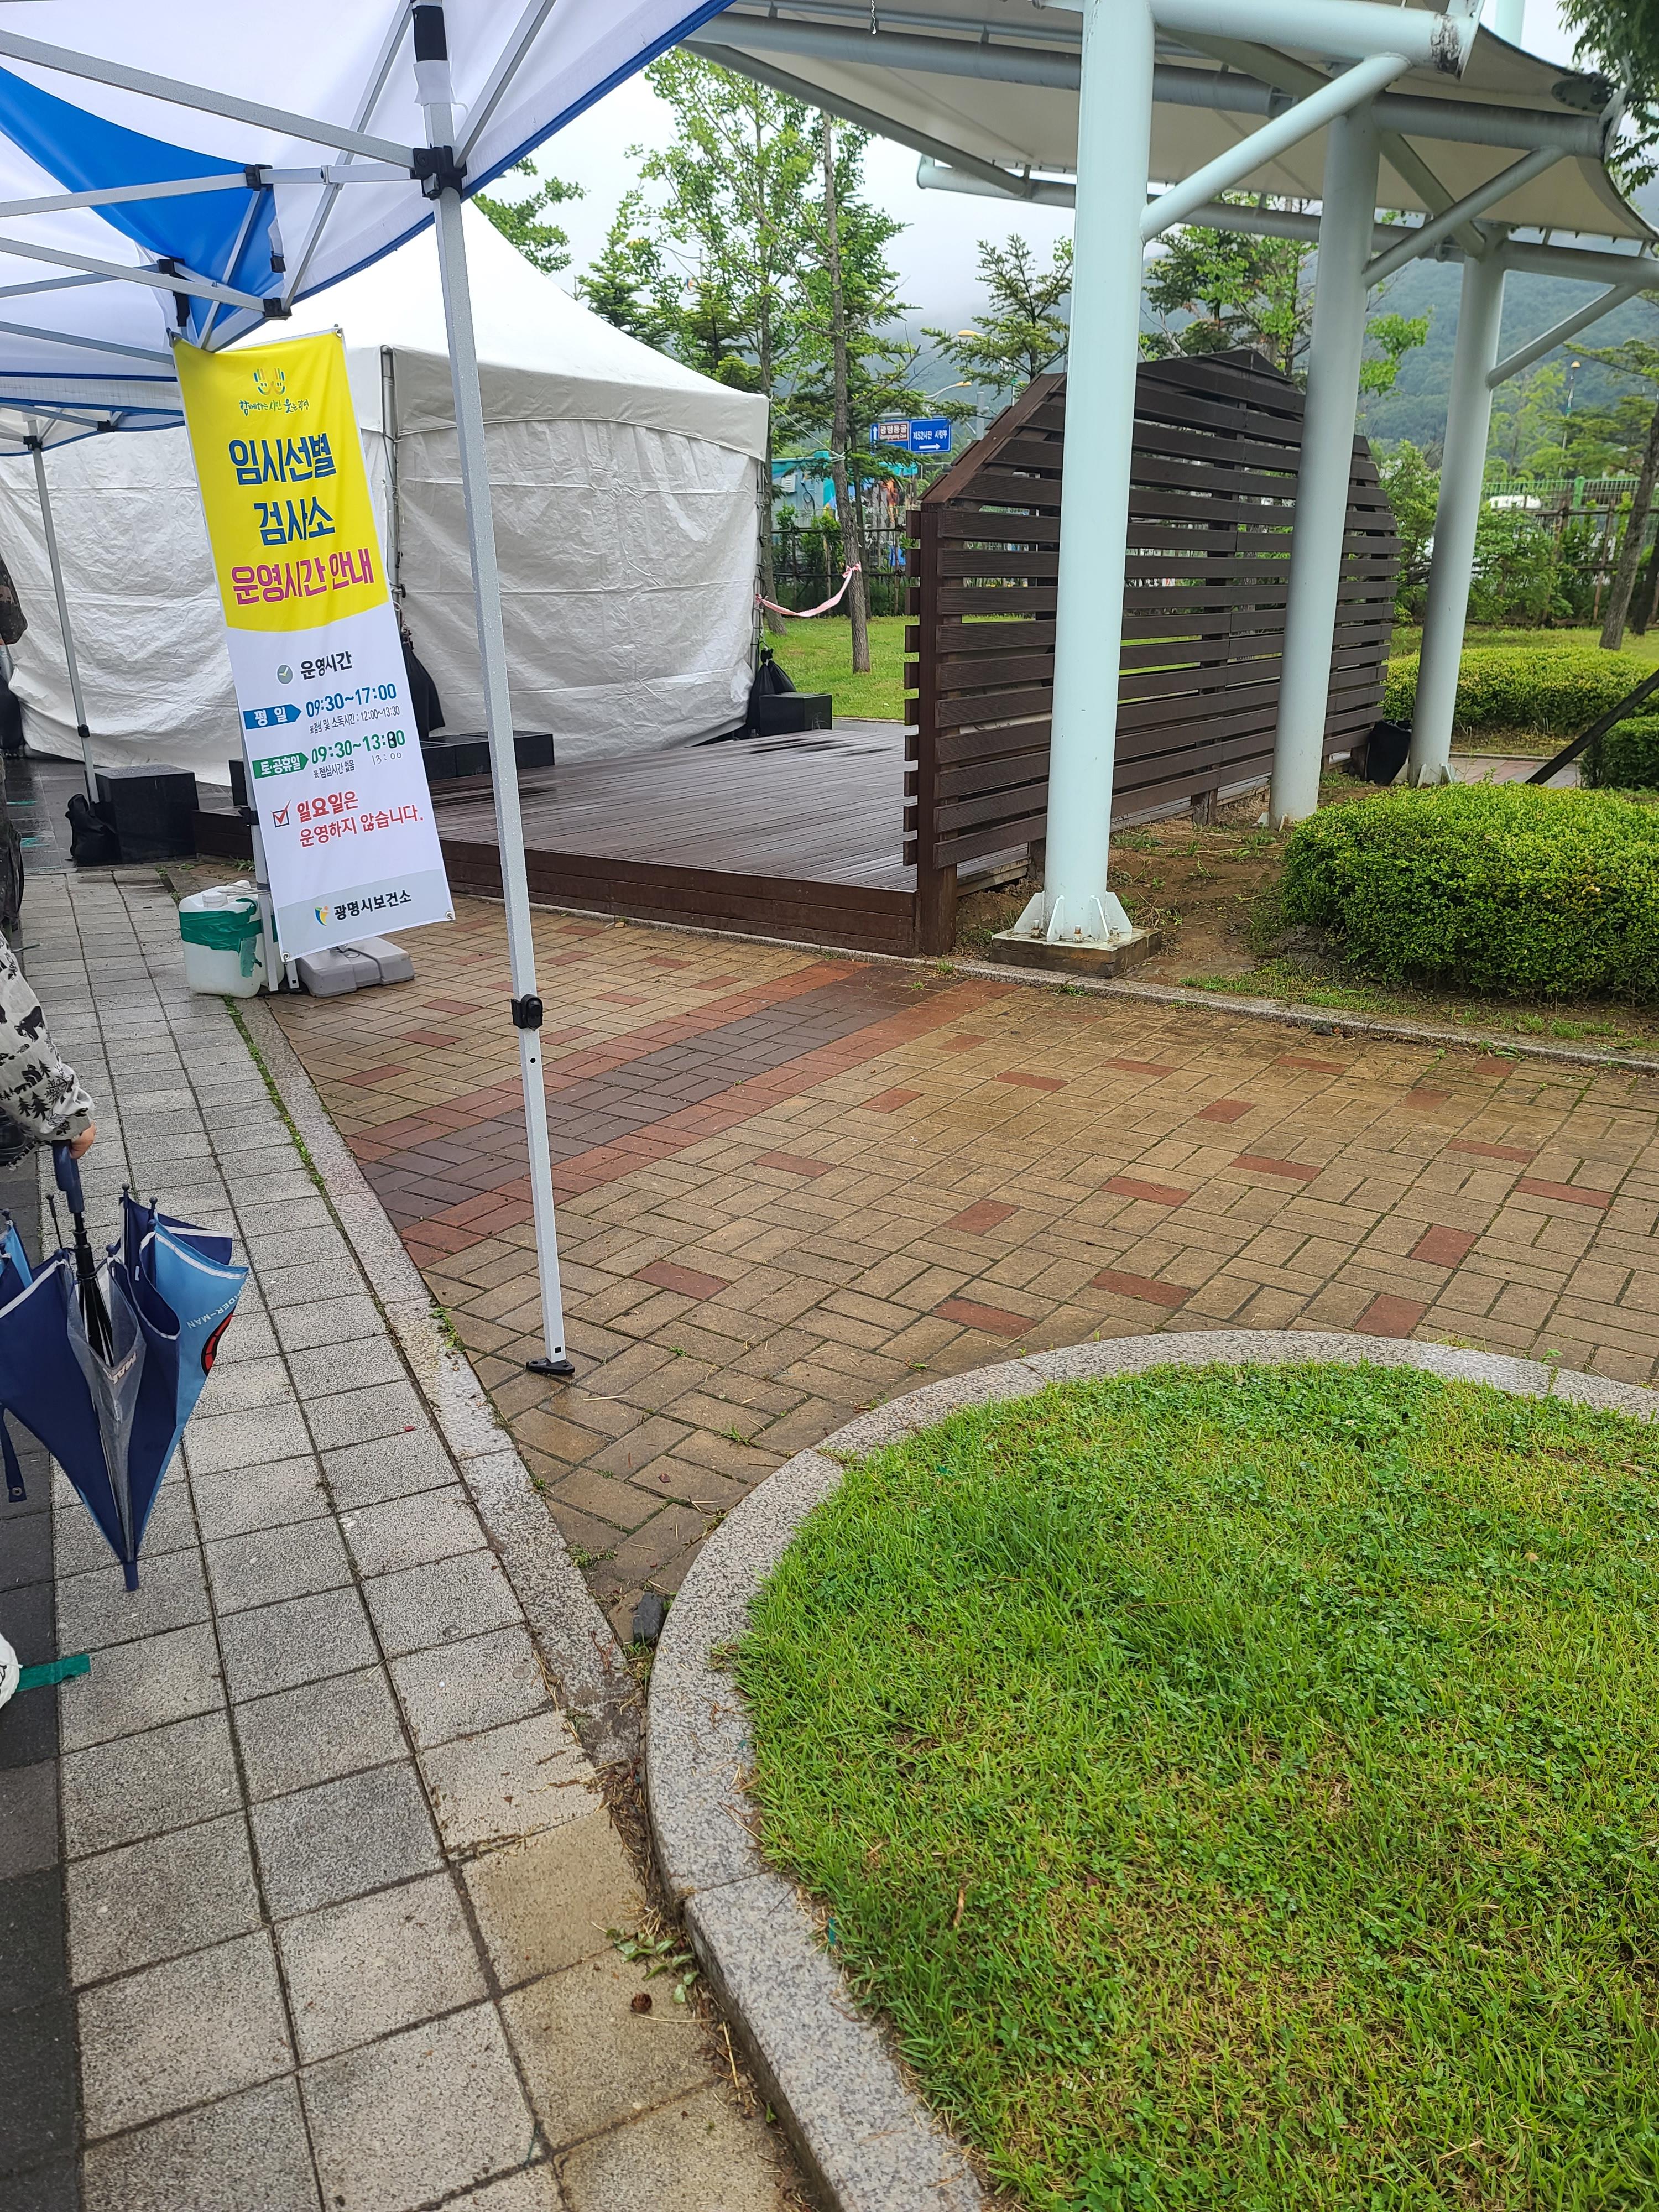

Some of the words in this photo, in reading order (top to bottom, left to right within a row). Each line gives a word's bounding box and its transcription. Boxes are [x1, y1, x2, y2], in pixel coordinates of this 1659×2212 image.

[269, 399, 283, 412] 시민
[912, 430, 933, 441] 제52사단
[229, 433, 337, 485] 임시선별
[253, 496, 336, 546] 검사소
[231, 557, 327, 605] 운영시간
[328, 547, 375, 591] 안내
[300, 651, 353, 680] 운영시간
[305, 683, 397, 718] 09:30~17:00
[323, 718, 331, 731] 및
[360, 705, 400, 722] 12:00~13:30
[344, 759, 355, 773] 없음
[296, 791, 358, 823] 일요일은
[299, 817, 358, 848] 운영하지
[360, 804, 424, 832] 않습니다.
[333, 889, 412, 921] 광명시보건소
[186, 1284, 245, 1329] IDER-MAN
